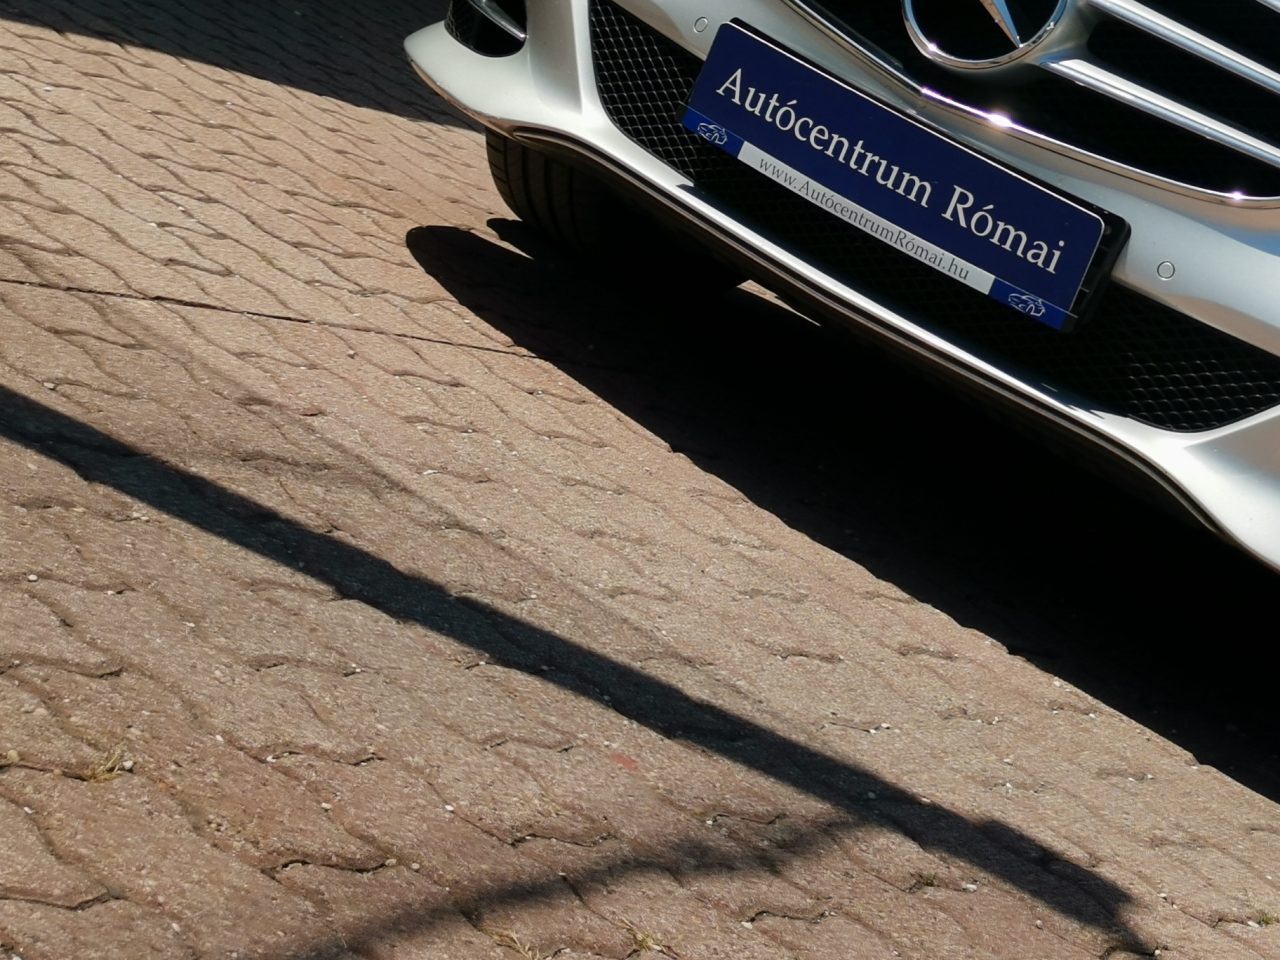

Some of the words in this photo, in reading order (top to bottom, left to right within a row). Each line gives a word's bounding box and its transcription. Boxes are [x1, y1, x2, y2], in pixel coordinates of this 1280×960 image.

[715, 67, 932, 207] Autócentrum
[941, 185, 1065, 275] Római
[759, 157, 970, 281] www.AutócentrumRómai.hu
